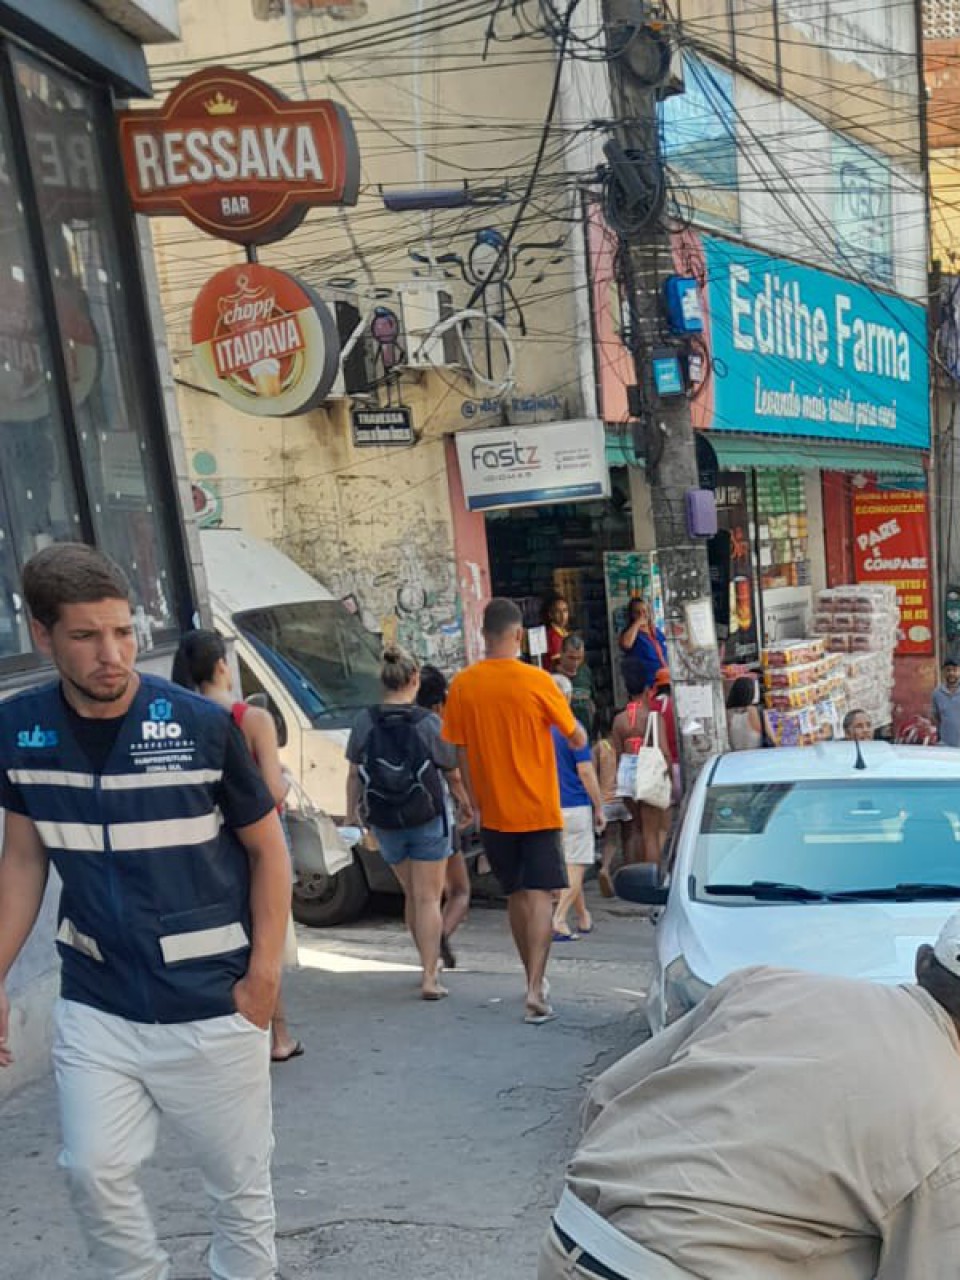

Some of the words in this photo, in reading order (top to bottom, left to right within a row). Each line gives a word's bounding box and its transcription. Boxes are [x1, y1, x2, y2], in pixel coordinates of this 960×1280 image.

[132, 125, 324, 192] RESSAKA
[220, 197, 250, 216] BAR
[729, 263, 829, 365] Edithe
[834, 293, 911, 382] Farma
[215, 319, 301, 373] ITAIPAVA
[754, 376, 800, 418] Levando
[801, 387, 827, 421] mais
[857, 518, 902, 551] PARE
[863, 556, 928, 571] COMPARE
[130, 739, 195, 750] PREFEITURA
[142, 721, 181, 740] Rio
